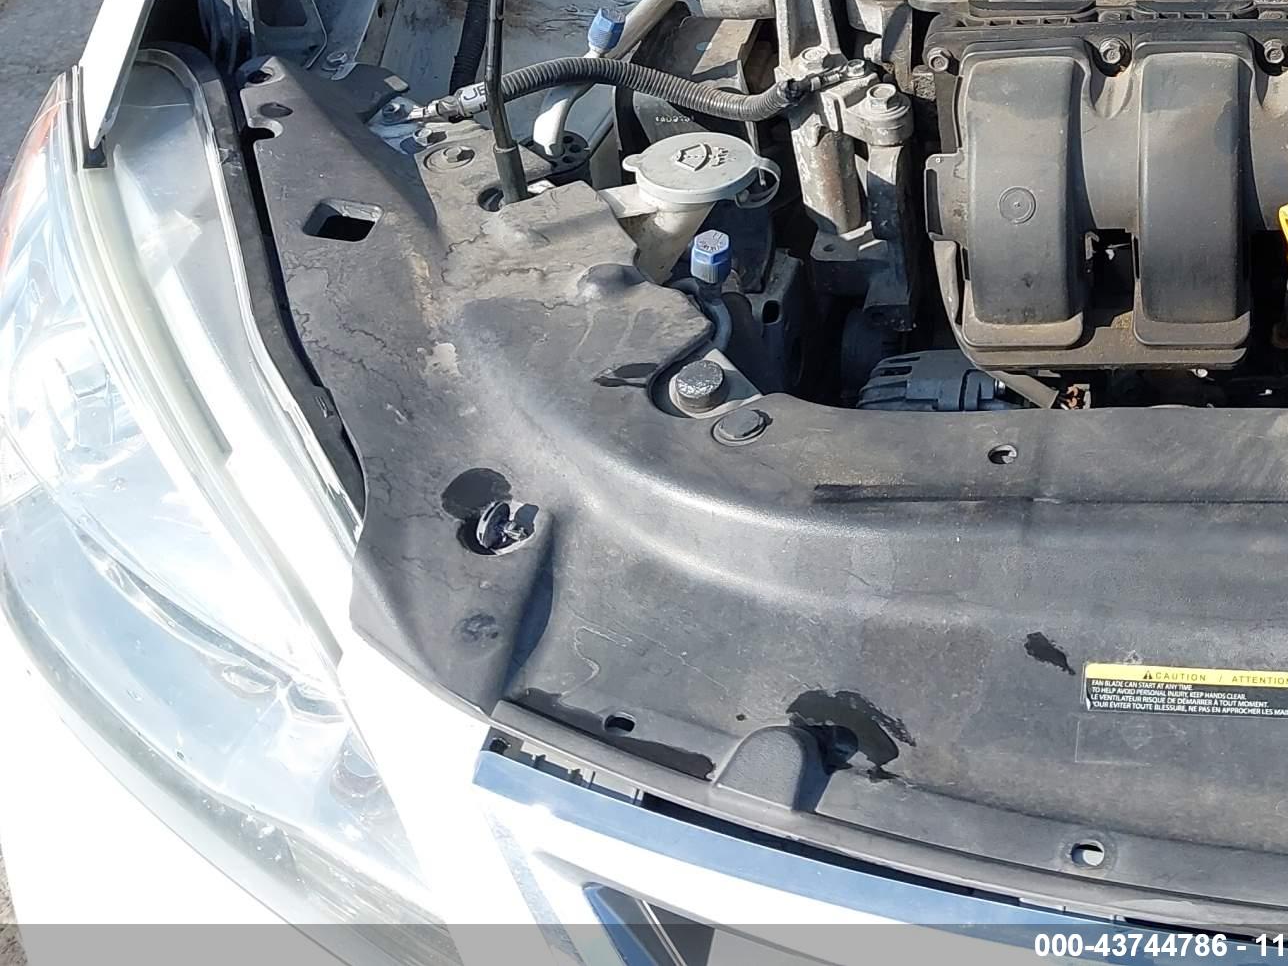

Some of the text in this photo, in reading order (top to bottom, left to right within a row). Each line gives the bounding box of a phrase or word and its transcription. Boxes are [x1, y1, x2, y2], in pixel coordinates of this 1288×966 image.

[1155, 672, 1207, 682] CAUTION
[1142, 696, 1166, 704] RISQUE
[1132, 702, 1153, 710] TOUTE
[1221, 707, 1261, 715] APPROCHER
